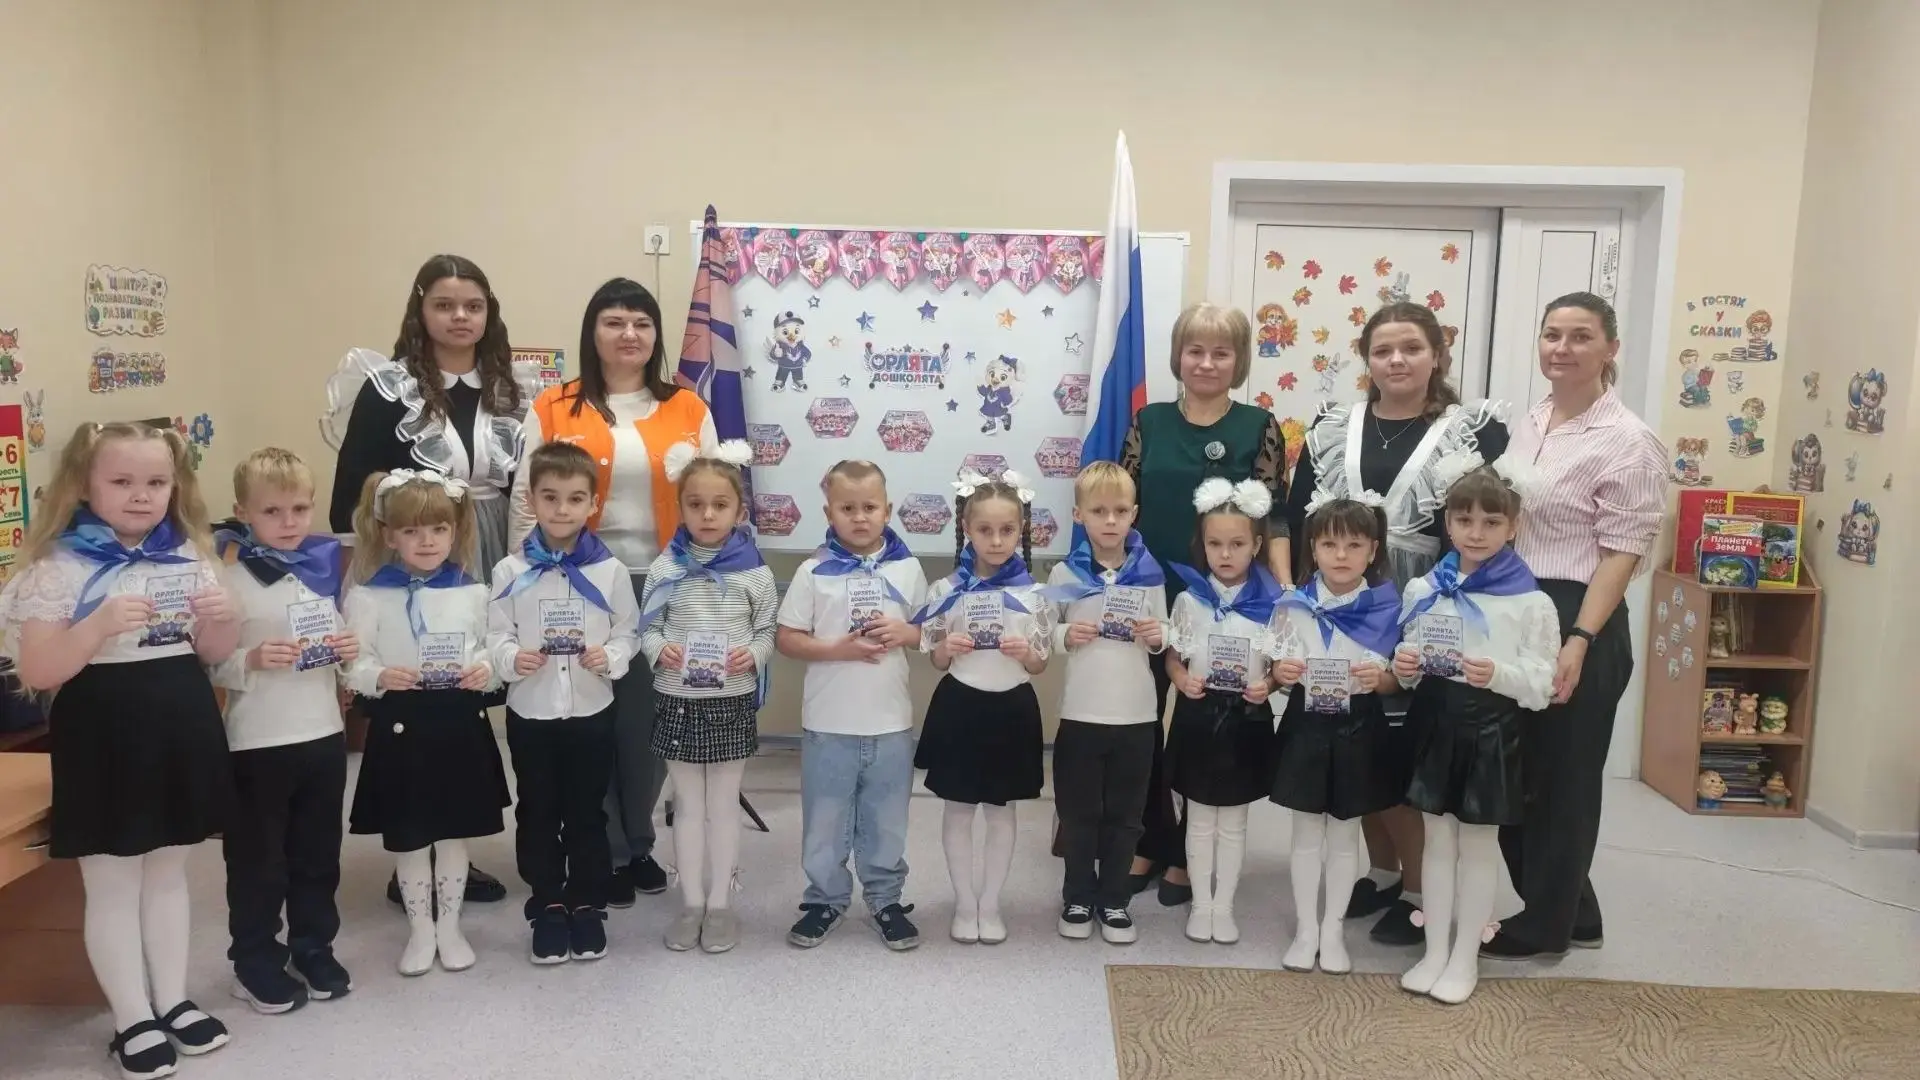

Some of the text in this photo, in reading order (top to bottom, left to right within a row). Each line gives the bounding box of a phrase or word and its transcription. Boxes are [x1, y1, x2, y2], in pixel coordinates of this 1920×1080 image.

[1702, 296, 1746, 308] ГОСТЯХ
[1716, 311, 1724, 322] У
[1690, 325, 1742, 338] СКАЗКИ
[871, 353, 942, 373] ОРЛЯТА
[874, 373, 942, 383] ДОШКОЛЯТА
[5, 443, 18, 465] 6
[8, 486, 20, 507] 7
[12, 527, 23, 548] 8
